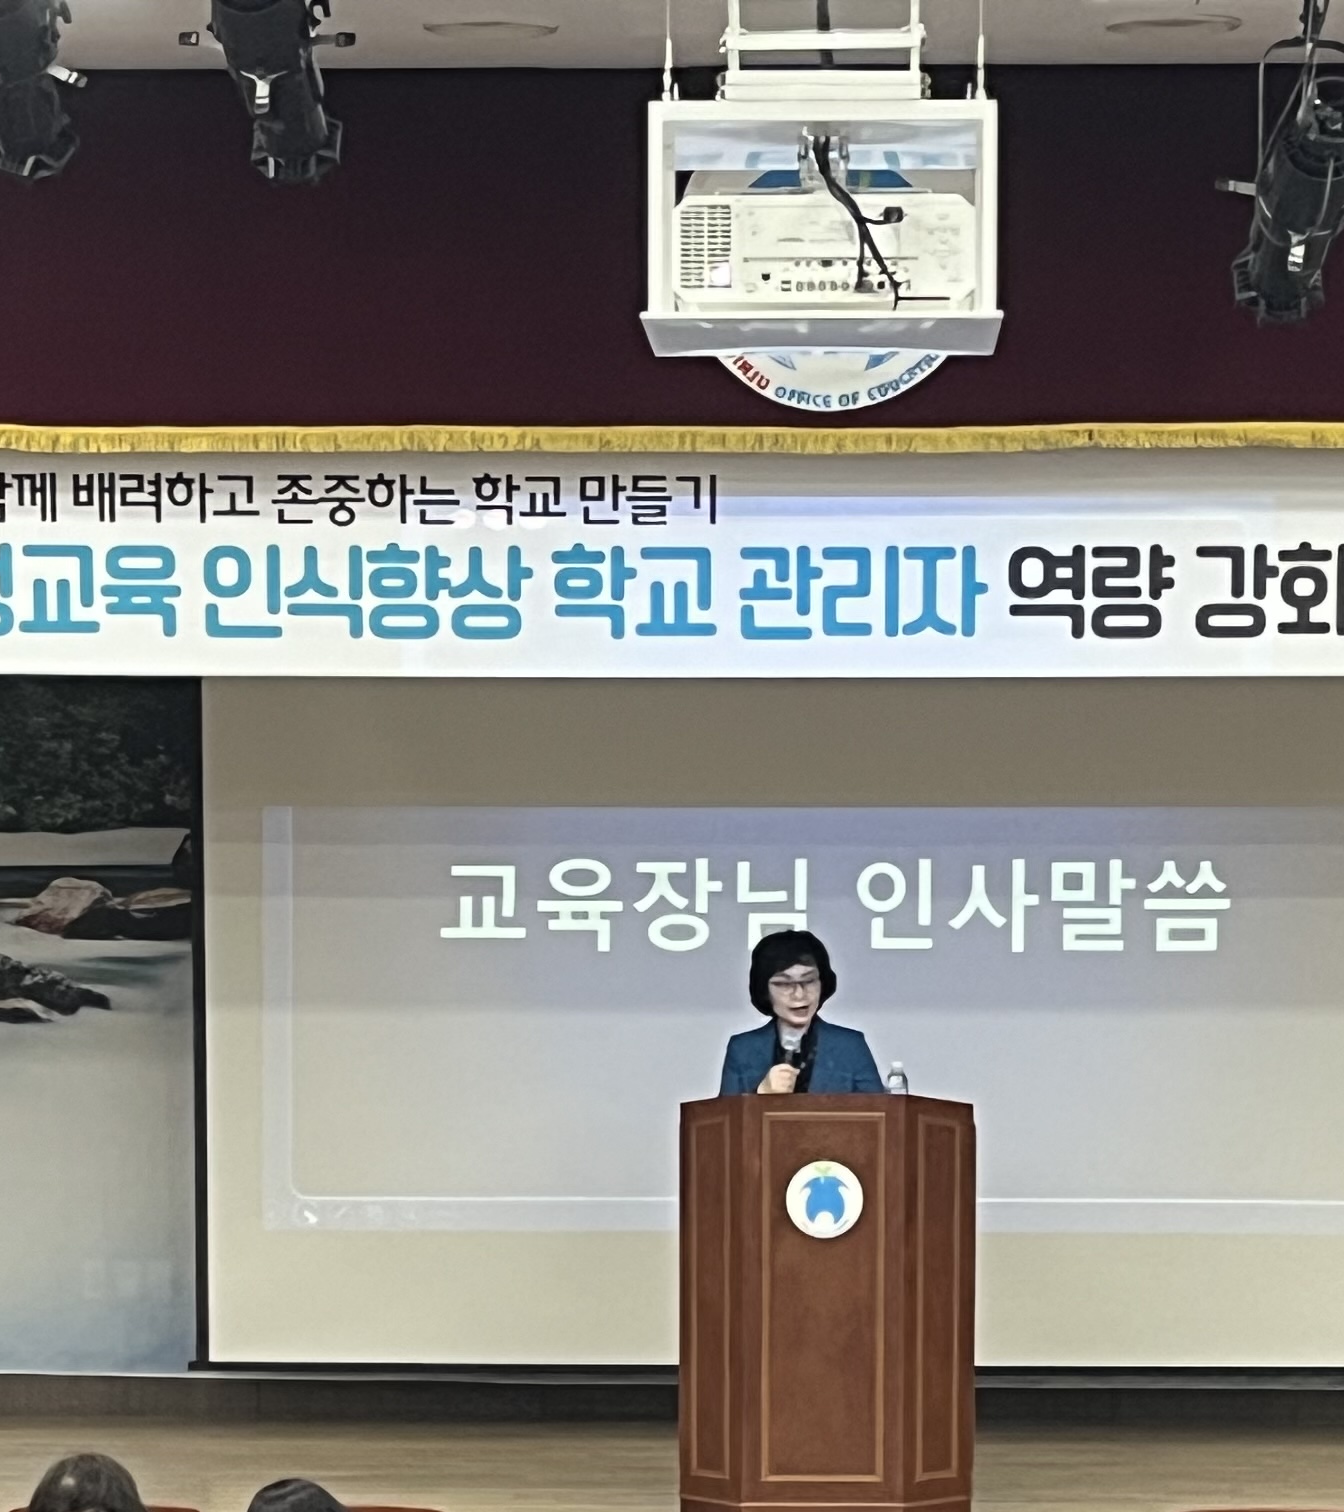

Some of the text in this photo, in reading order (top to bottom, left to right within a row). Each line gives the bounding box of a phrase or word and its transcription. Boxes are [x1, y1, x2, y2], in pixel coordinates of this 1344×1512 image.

[838, 389, 860, 408] OF
[72, 471, 260, 524] 배려하고
[271, 472, 461, 527] 존중하는
[471, 472, 567, 526] 학교
[579, 473, 717, 526] 만들기
[204, 544, 533, 640] 인식향상
[553, 543, 718, 640] 학교
[738, 544, 989, 641] 관리자
[1007, 543, 1176, 640] 역량
[440, 857, 1231, 954] 교육장님 인사말씀
